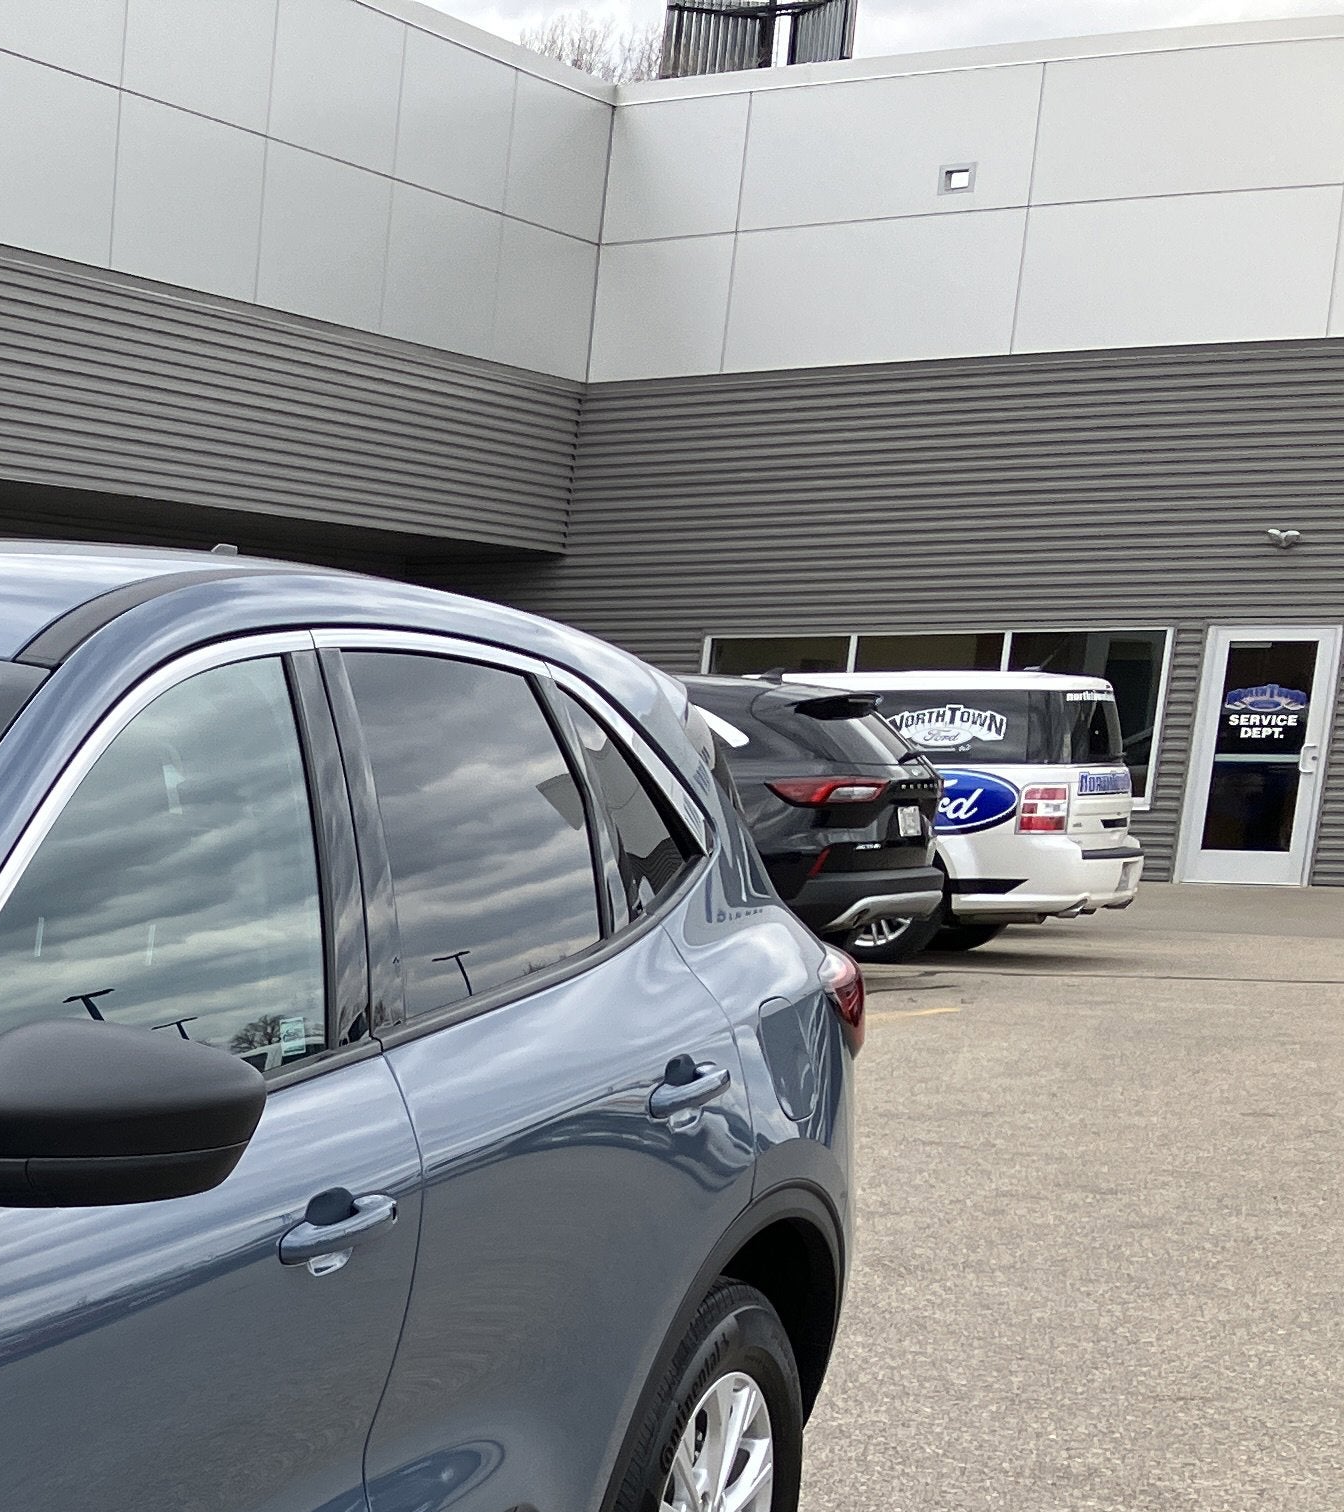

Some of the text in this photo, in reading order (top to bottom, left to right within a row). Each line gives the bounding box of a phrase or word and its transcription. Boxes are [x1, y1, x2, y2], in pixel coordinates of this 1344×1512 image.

[1228, 714, 1299, 726] SERVICE
[923, 728, 961, 742] Ford
[1239, 726, 1285, 739] DEPT.
